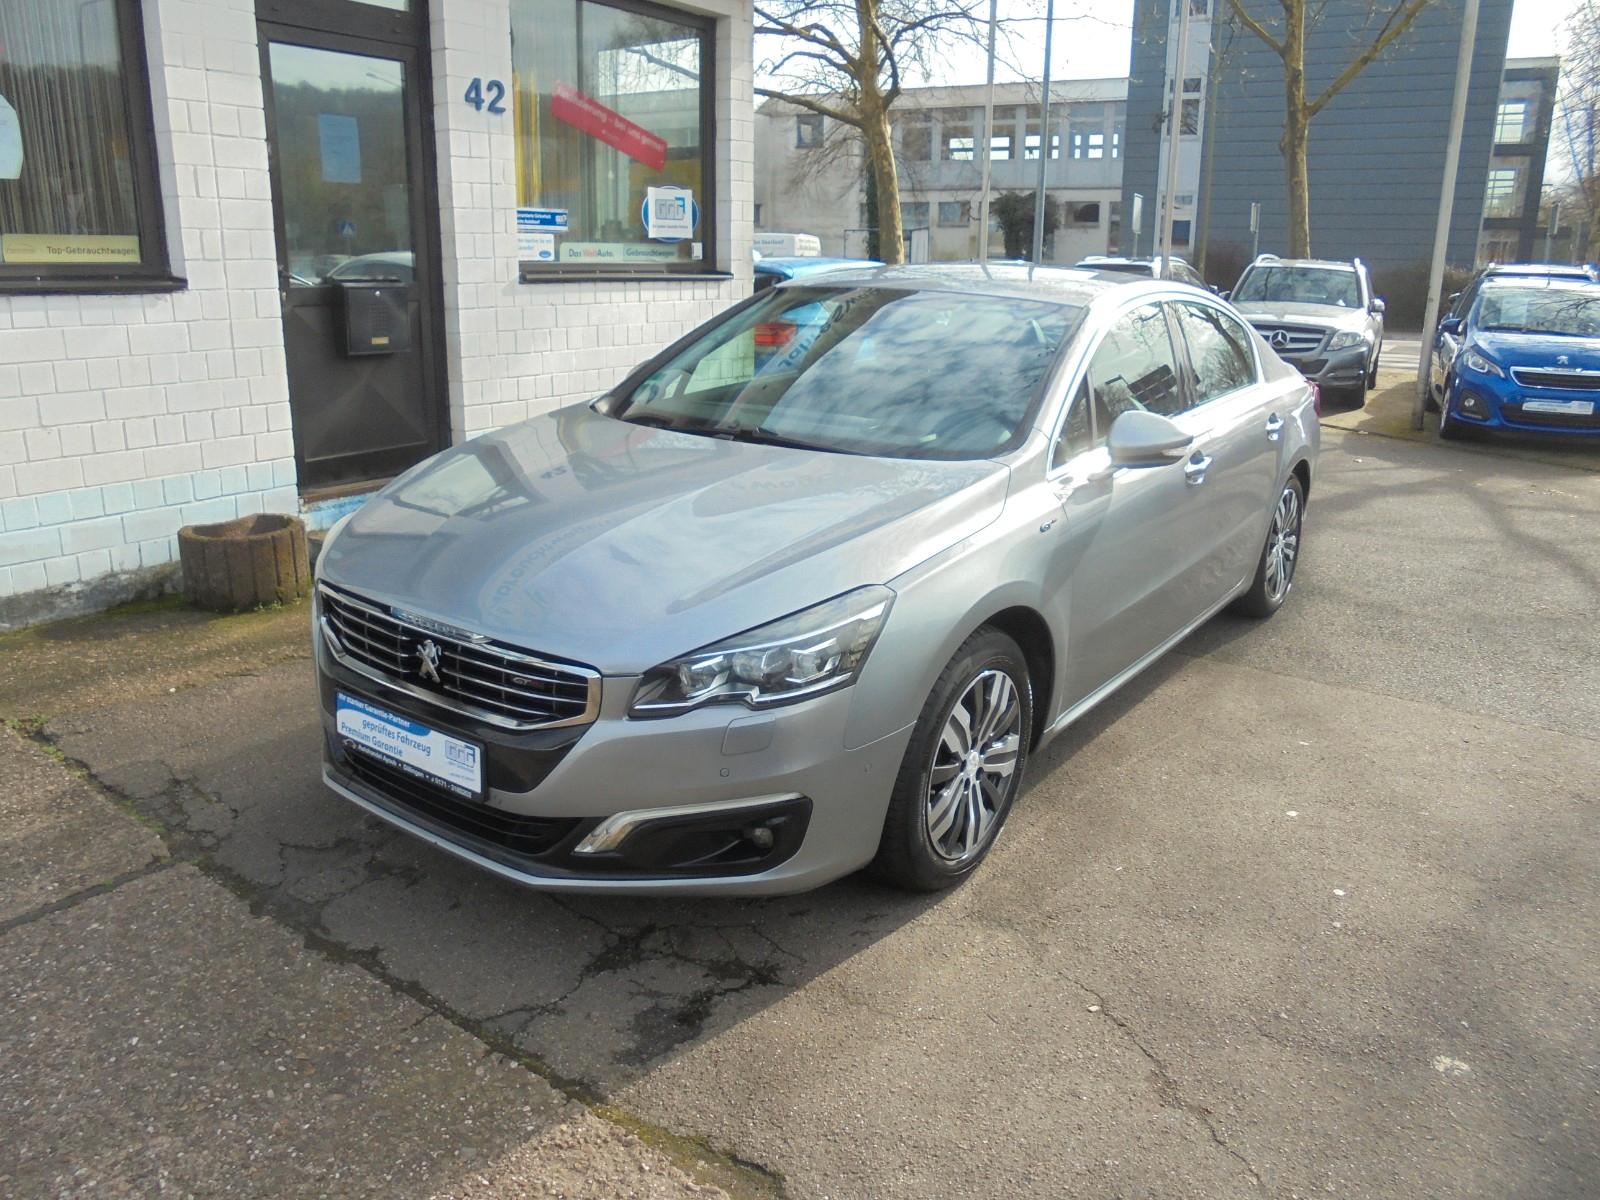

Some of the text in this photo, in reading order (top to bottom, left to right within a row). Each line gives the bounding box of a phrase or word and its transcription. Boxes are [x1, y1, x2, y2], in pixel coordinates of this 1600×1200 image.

[464, 77, 506, 113] 42
[46, 246, 138, 256] Top-Gebrauchtwagen
[568, 248, 582, 257] Das
[341, 721, 403, 757] Premium Garantie
[362, 719, 431, 757] geprüftes Fahrzeug
